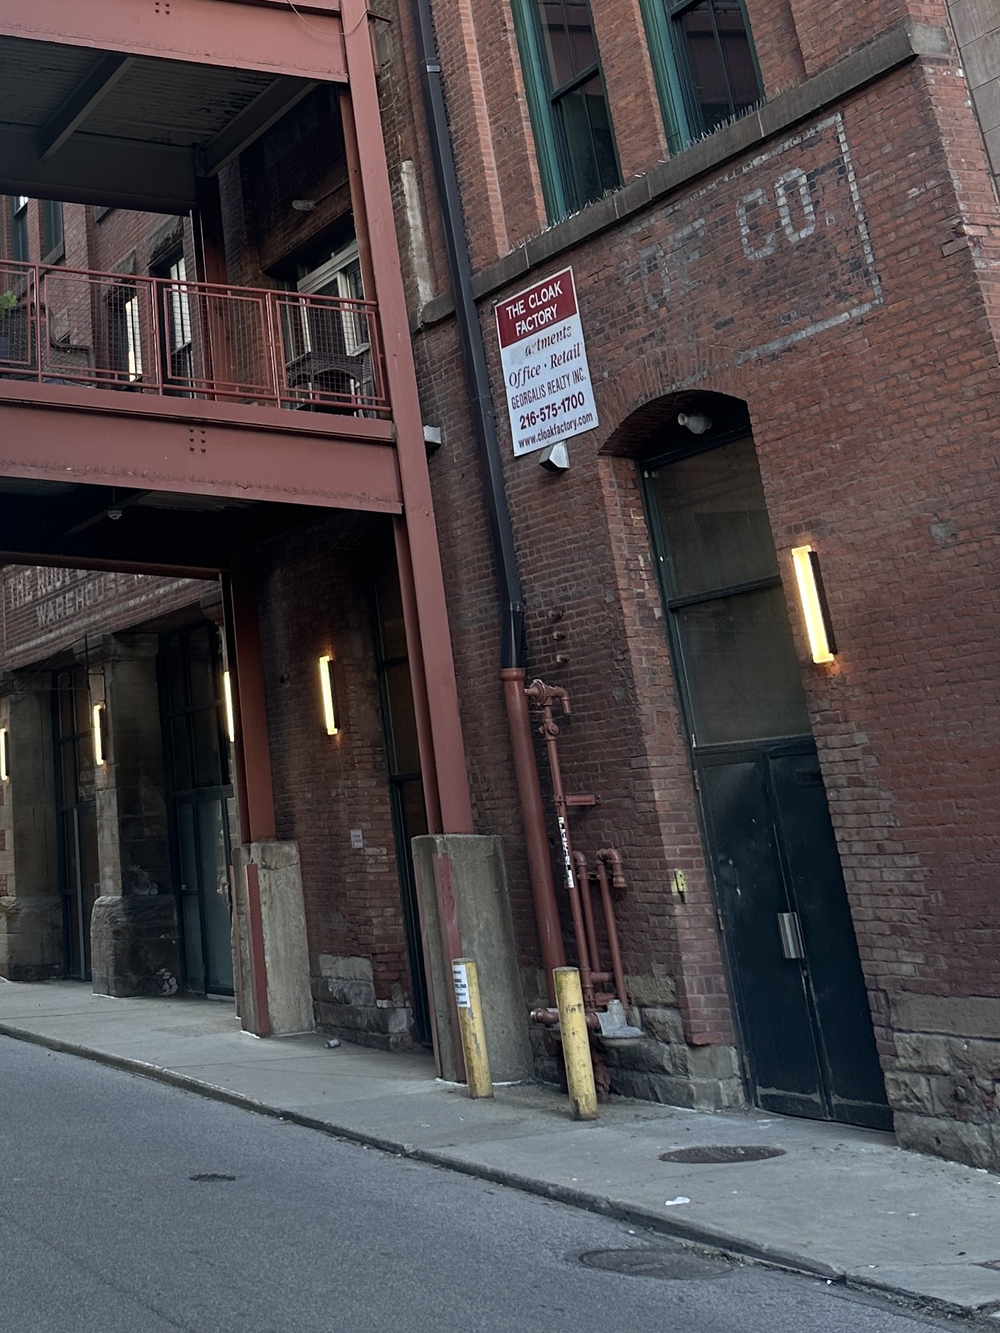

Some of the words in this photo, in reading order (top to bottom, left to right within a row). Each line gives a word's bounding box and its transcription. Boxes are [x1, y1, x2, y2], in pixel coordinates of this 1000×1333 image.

[506, 299, 526, 320] THE
[528, 280, 563, 308] CLOAK
[515, 303, 558, 337] FACTORY
[509, 363, 541, 389] Office
[550, 342, 581, 370] Retail
[511, 383, 547, 410] GEORGALIS
[546, 372, 572, 396] REALTY
[572, 367, 587, 384] INC.
[518, 412, 594, 448] www.cloakfactory.com
[519, 391, 585, 430] 216-575-1700
